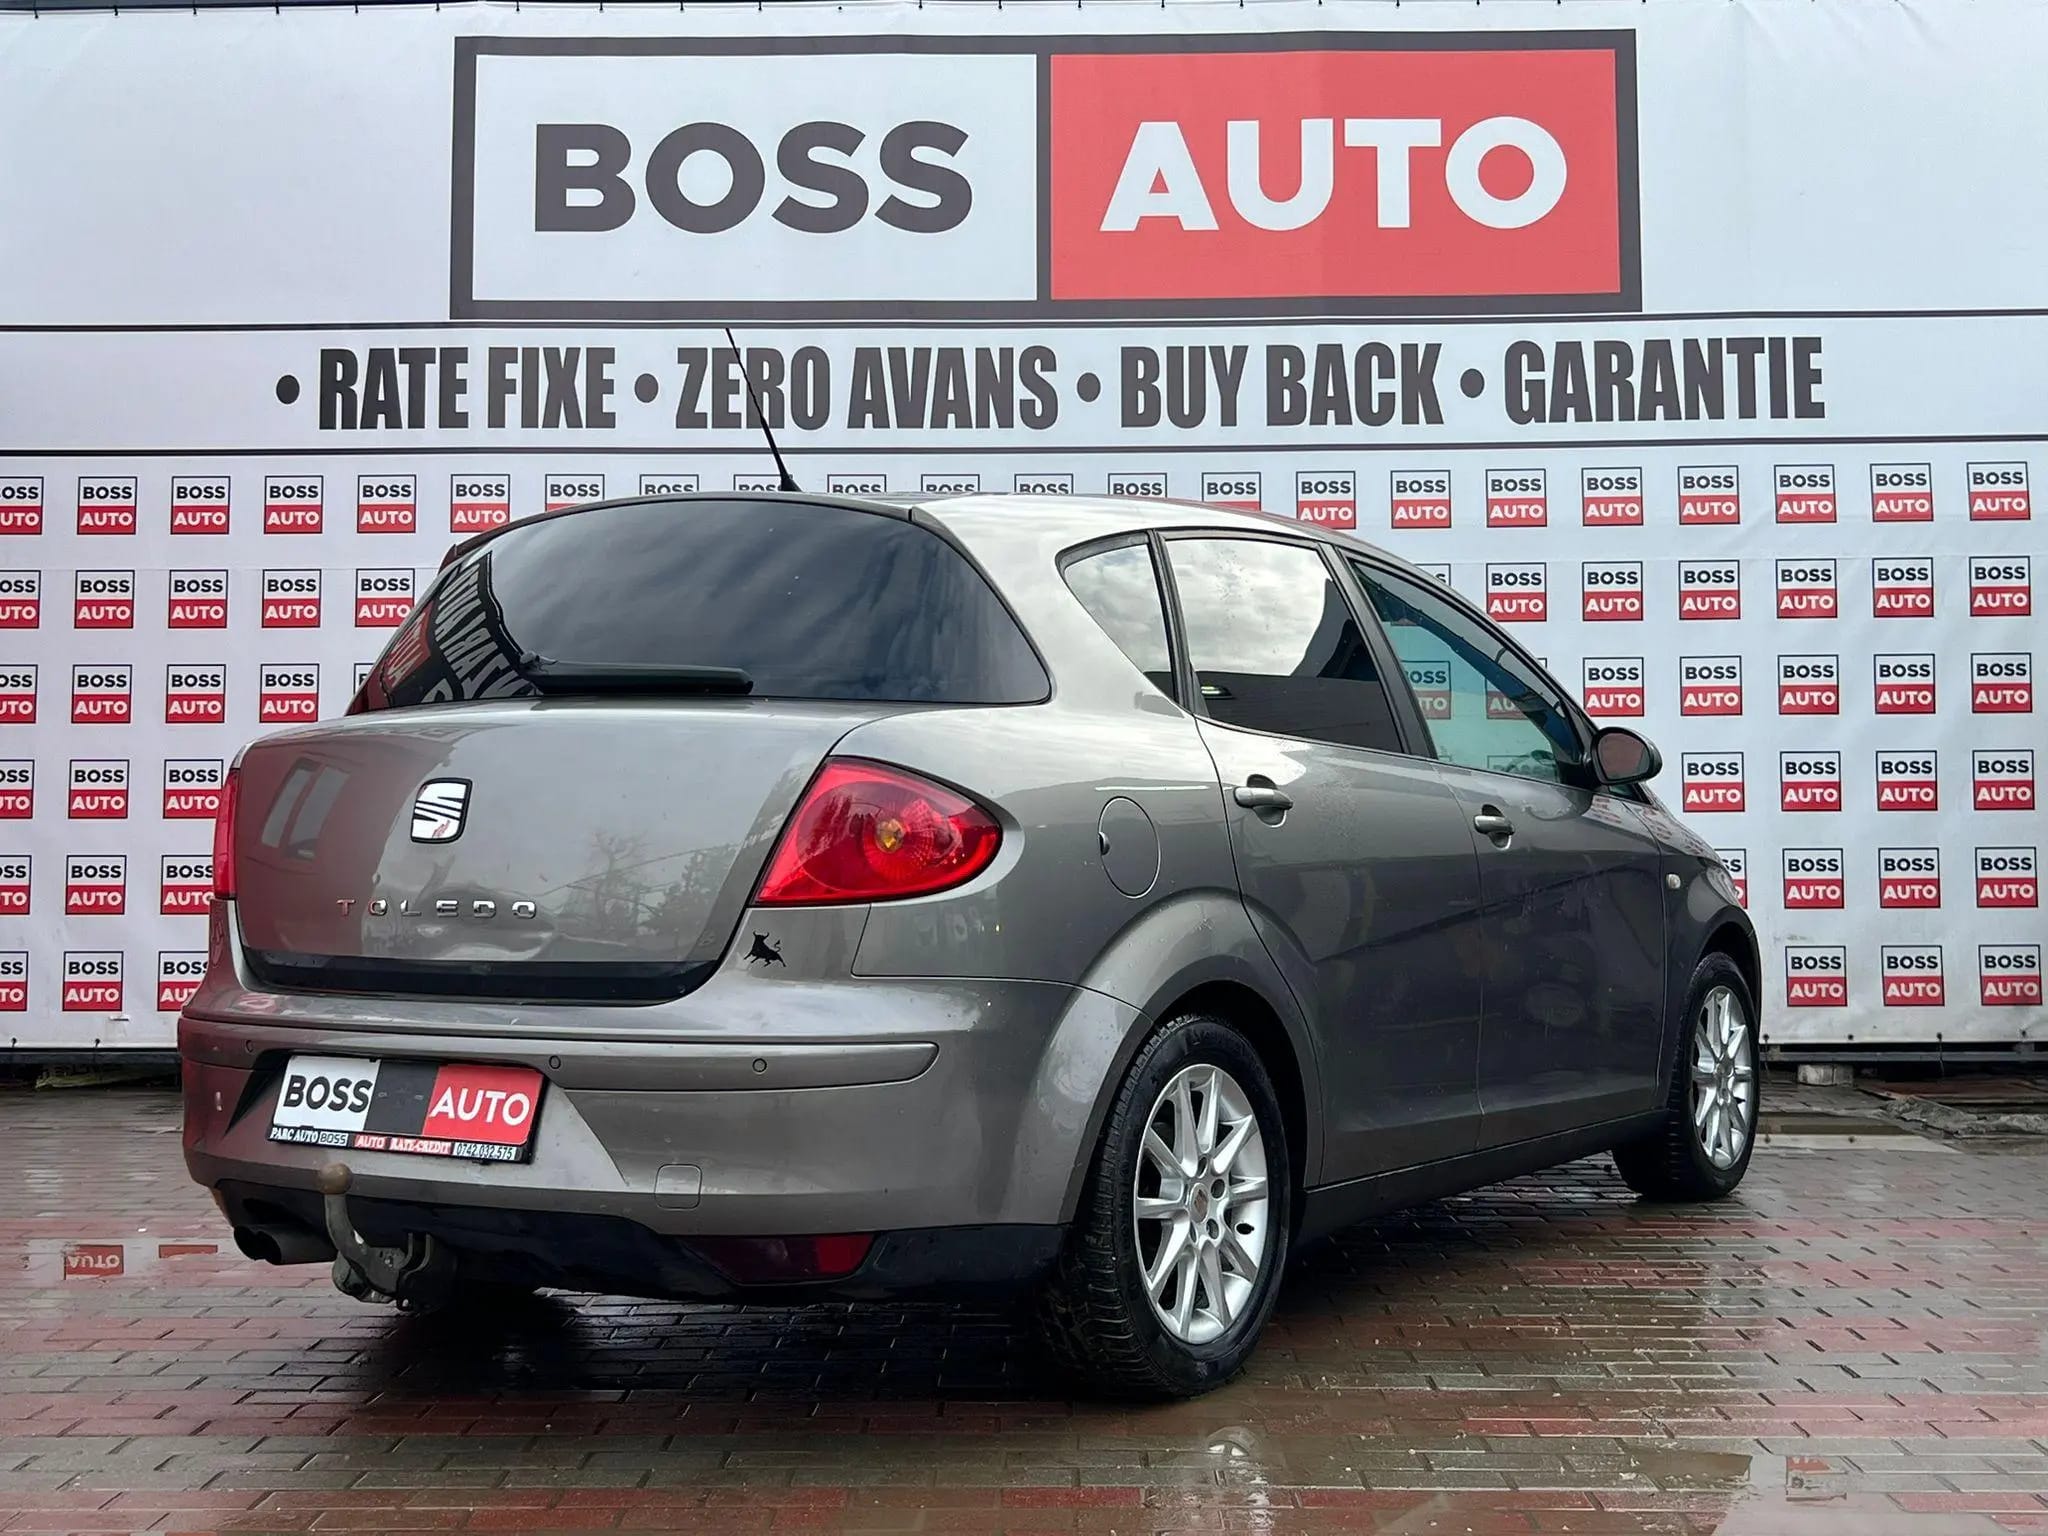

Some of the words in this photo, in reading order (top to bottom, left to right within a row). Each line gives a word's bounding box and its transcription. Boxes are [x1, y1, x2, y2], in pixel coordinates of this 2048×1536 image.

[535, 121, 972, 233] BOSS
[1101, 115, 1568, 232] AUTO
[319, 347, 468, 430] RATE
[488, 347, 616, 429] FIXE
[676, 346, 830, 429] ZERO
[848, 346, 1058, 429] AVANS
[1121, 344, 1248, 428] BUY
[1267, 342, 1443, 426] BACK
[1505, 337, 1825, 424] GARANTIE
[1587, 477, 1637, 490] BOSS
[1683, 476, 1734, 488] BOSS
[1779, 475, 1830, 487] BOSS
[1875, 474, 1926, 486] BOSS
[1972, 472, 2023, 484] BOSS
[362, 485, 411, 497] BOSS
[455, 484, 505, 496] BOSS
[550, 484, 599, 497] BOSS
[1113, 482, 1163, 495] BOSS
[1207, 482, 1256, 494] BOSS
[1301, 481, 1350, 494] BOSS
[1396, 480, 1445, 492] BOSS
[1491, 479, 1541, 491] BOSS
[0, 487, 39, 499] OSS
[82, 487, 132, 499] BOSS
[176, 486, 225, 498] BOSS
[269, 486, 318, 498] BOSS
[1490, 504, 1544, 519] AUTO
[1585, 503, 1640, 517] AUTO
[1682, 502, 1737, 516] AUTO
[1778, 500, 1833, 514] AUTO
[1875, 499, 1930, 513] AUTO
[1973, 498, 2027, 512] AUTO
[0, 513, 39, 525] UTO
[80, 513, 132, 525] AUTO
[174, 512, 226, 525] AUTO
[267, 512, 319, 525] AUTO
[360, 511, 412, 524] AUTO
[454, 510, 506, 523] AUTO
[1300, 507, 1353, 521] AUTO
[1395, 506, 1448, 520] AUTO
[1491, 573, 1541, 585] BOSS
[1587, 572, 1638, 584] BOSS
[1683, 570, 1735, 583] BOSS
[1781, 569, 1831, 582] BOSS
[1877, 568, 1928, 580] BOSS
[1974, 567, 2025, 579] BOSS
[0, 580, 36, 593] OSS
[80, 580, 129, 592] BOSS
[173, 580, 223, 592] BOSS
[267, 579, 316, 592] BOSS
[360, 578, 409, 591] BOSS
[1490, 599, 1543, 613] AUTO
[1585, 598, 1639, 612] AUTO
[1682, 597, 1737, 611] AUTO
[1780, 595, 1834, 609] AUTO
[1877, 594, 1930, 608] AUTO
[1974, 593, 2027, 607] AUTO
[0, 606, 37, 619] UTO
[78, 606, 130, 619] AUTO
[172, 606, 223, 619] AUTO
[265, 606, 317, 618] AUTO
[358, 605, 411, 618] AUTO
[1588, 668, 1638, 680] BOSS
[1685, 666, 1736, 679] BOSS
[1783, 665, 1834, 678] BOSS
[1879, 664, 1930, 677] BOSS
[1976, 663, 2026, 676] BOSS
[0, 675, 33, 687] OSS
[77, 675, 126, 687] BOSS
[171, 674, 220, 687] BOSS
[265, 674, 314, 687] BOSS
[1404, 671, 1447, 684] OSS
[1587, 694, 1640, 708] AUTO
[1684, 692, 1738, 707] AUTO
[1782, 692, 1835, 705] AUTO
[1878, 691, 1932, 704] AUTO
[1976, 690, 2028, 704] AUTO
[75, 701, 127, 714] AUTO
[169, 701, 221, 714] AUTO
[263, 700, 315, 713] AUTO
[1687, 762, 1739, 775] BOSS
[1785, 762, 1836, 774] BOSS
[1881, 761, 1932, 774] BOSS
[1977, 760, 2029, 773] BOSS
[74, 770, 124, 782] BOSS
[168, 770, 218, 782] BOSS
[1686, 789, 1741, 803] AUTO
[1784, 789, 1837, 802] AUTO
[1881, 788, 1933, 801] AUTO
[1977, 787, 2031, 800] AUTO
[72, 796, 124, 809] AUTO
[166, 796, 219, 809] AUTO
[1787, 859, 1838, 872] BOSS
[1883, 858, 1935, 871] BOSS
[1980, 857, 2032, 870] BOSS
[71, 865, 121, 878] BOSS
[1787, 886, 1840, 899] AUTO
[1884, 885, 1936, 899] AUTO
[1980, 885, 2033, 898] AUTO
[69, 892, 121, 905] AUTO
[337, 898, 538, 920] TOLEDO
[68, 962, 118, 974] BOSS
[1790, 956, 1841, 969] BOSS
[1886, 956, 1938, 969] BOSS
[1984, 955, 2036, 968] BOSS
[66, 989, 119, 1001] AUTO
[1791, 984, 1843, 997] AUTO
[1887, 983, 1940, 996] AUTO
[1985, 983, 2037, 996] AUTO
[282, 1074, 373, 1113] BOSS
[429, 1085, 531, 1126] AUTO
[269, 1127, 294, 1140] PARC
[295, 1130, 319, 1144] AUTO
[320, 1132, 346, 1145] BOSS
[355, 1135, 385, 1149] AUTO
